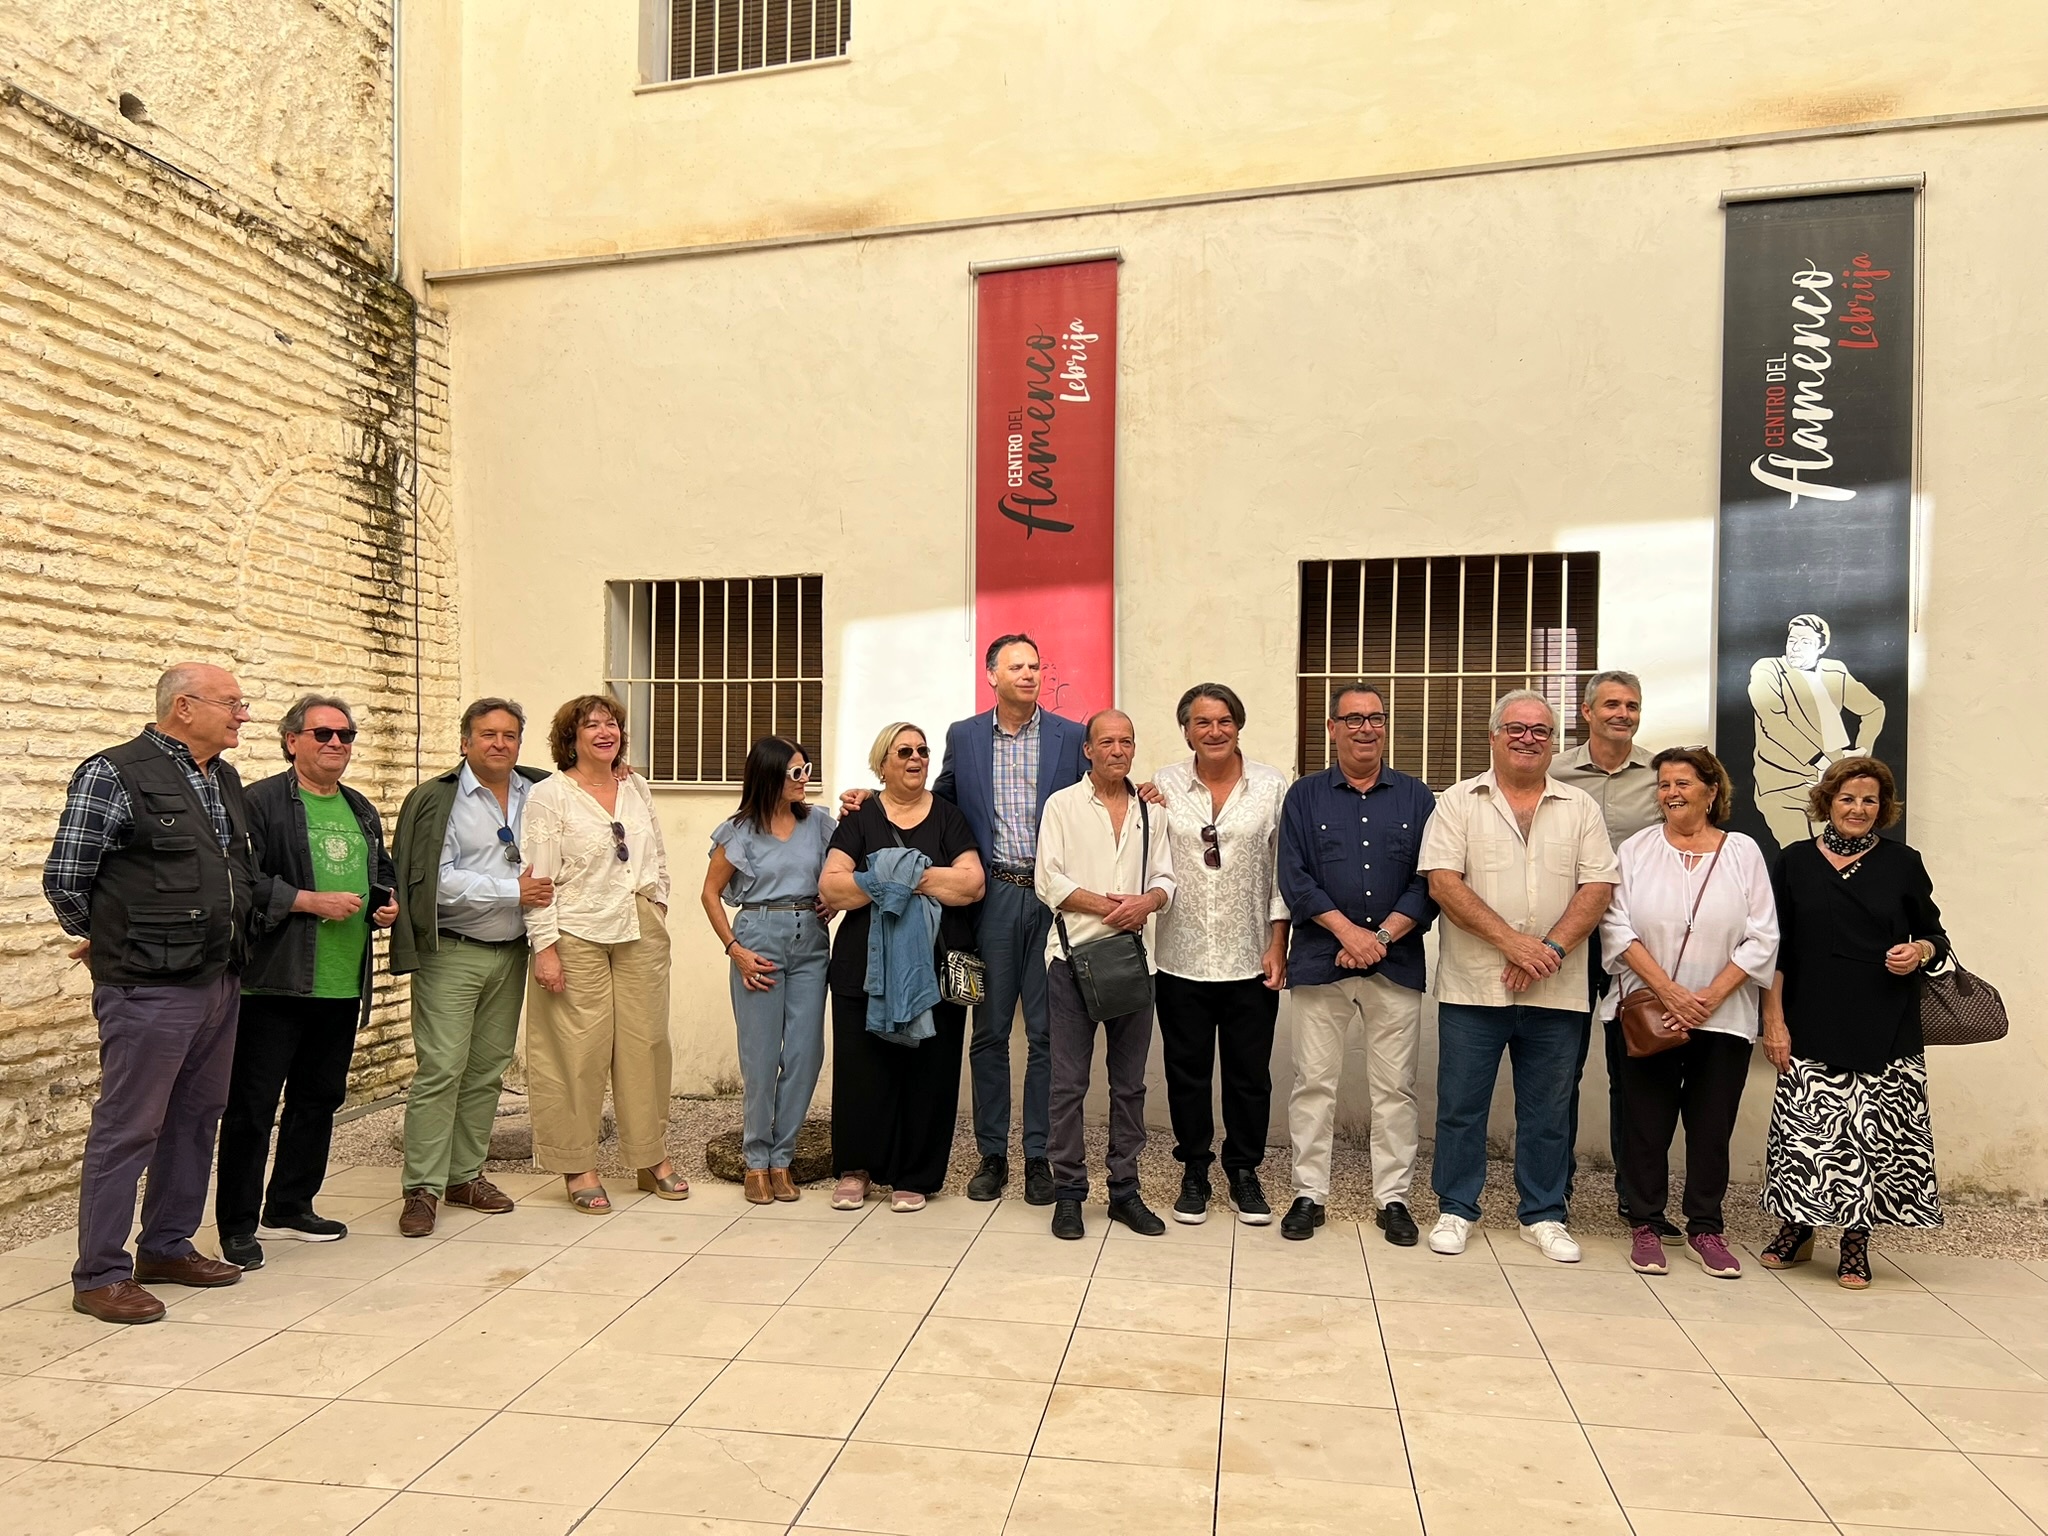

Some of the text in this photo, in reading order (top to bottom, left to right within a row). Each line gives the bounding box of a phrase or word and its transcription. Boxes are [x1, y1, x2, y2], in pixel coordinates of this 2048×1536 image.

[1838, 251, 1891, 350] Lebrija
[1059, 317, 1098, 403] Lebrija
[1750, 257, 1857, 510] flamenco
[1765, 352, 1787, 448] CENTRO DEL
[998, 323, 1074, 540] flamenco
[1007, 405, 1023, 487] CENTRO DEL
